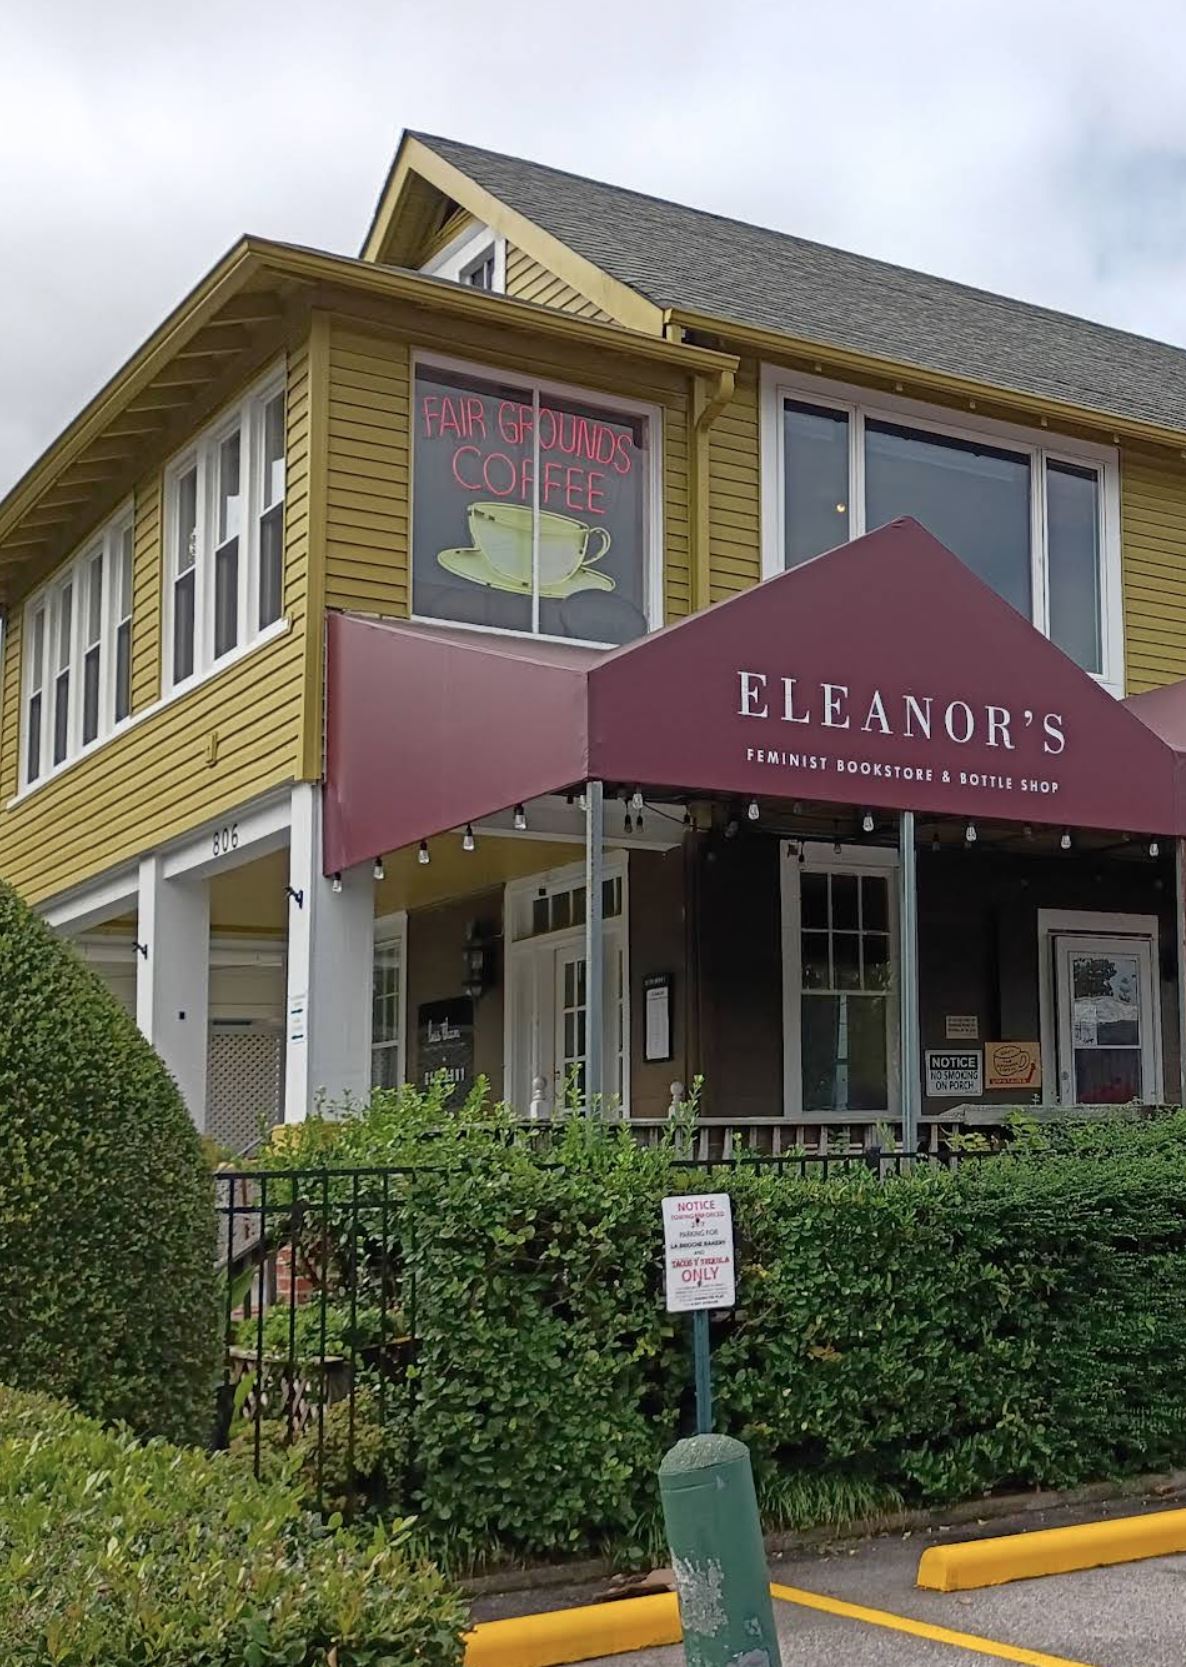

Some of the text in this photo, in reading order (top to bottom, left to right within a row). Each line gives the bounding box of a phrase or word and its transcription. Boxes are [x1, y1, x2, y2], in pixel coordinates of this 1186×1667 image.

[423, 396, 487, 440] FAIR
[452, 445, 607, 514] COFFEE
[737, 671, 1066, 755] ELEANOR'S
[747, 748, 1059, 795] FEMINIST BOOKSTORE & BOTTLE SHOP
[213, 823, 239, 857] 806
[931, 1056, 976, 1068] NOTICE
[930, 1070, 978, 1080] NO SMOKING
[935, 1080, 974, 1090] ON PORCH
[678, 1200, 716, 1211] NOTICE
[681, 1266, 719, 1283] ONLY
